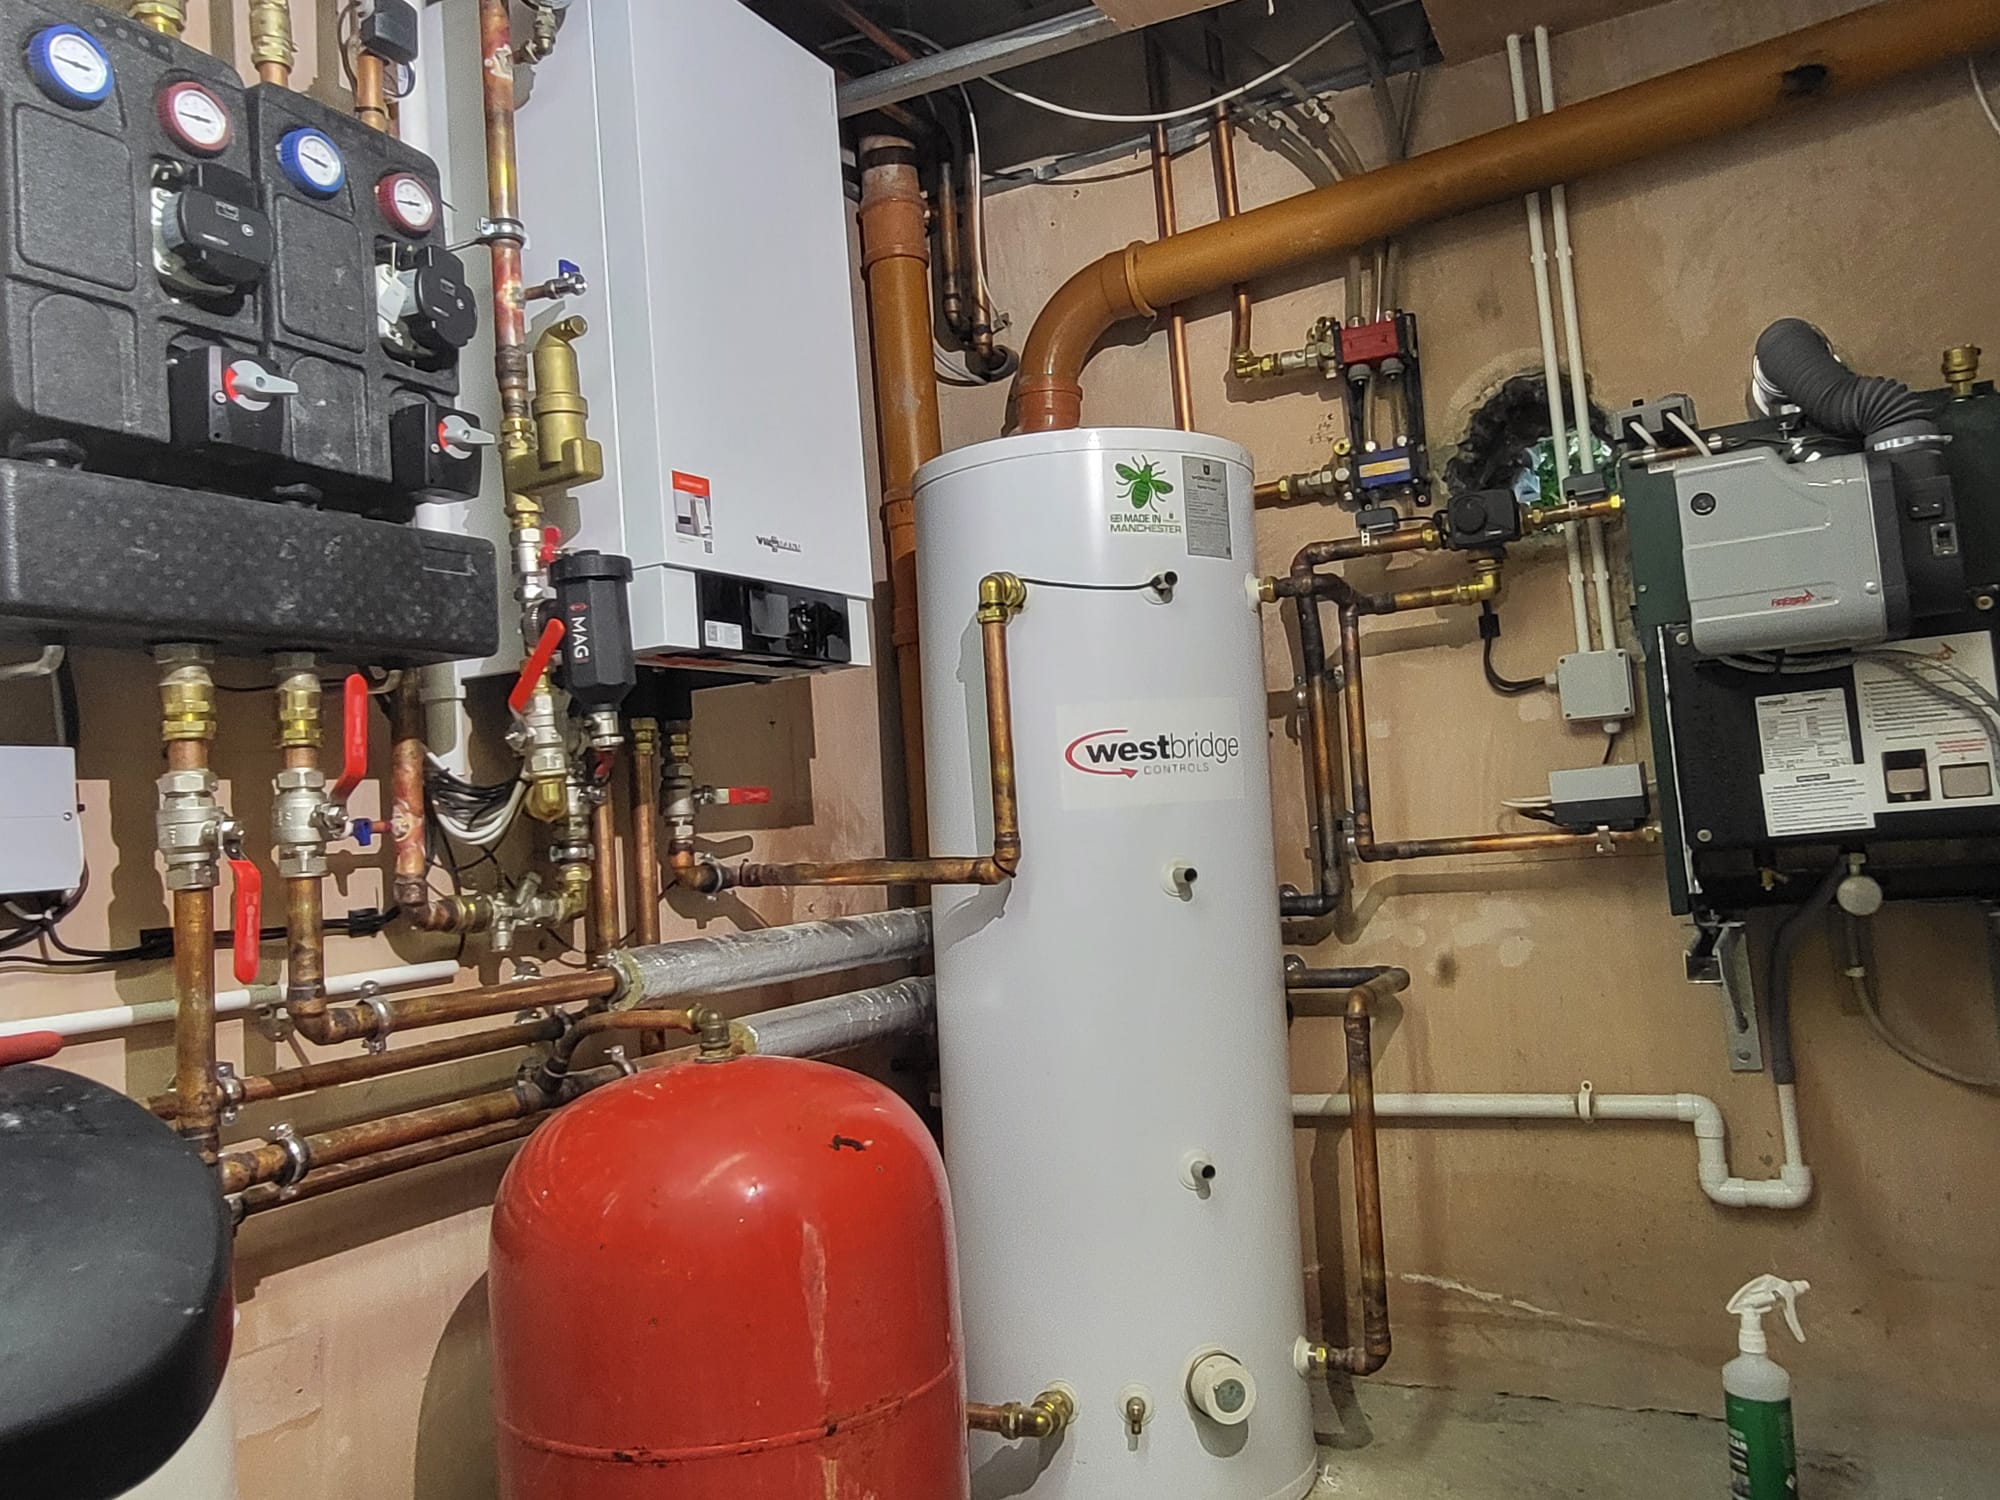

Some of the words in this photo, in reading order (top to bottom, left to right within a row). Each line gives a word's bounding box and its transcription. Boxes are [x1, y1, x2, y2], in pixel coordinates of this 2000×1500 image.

[1124, 513, 1150, 523] MADE
[1152, 514, 1161, 523] IN
[1110, 524, 1182, 534] MANCHESTER
[1085, 731, 1239, 764] westbridge
[1143, 763, 1210, 775] CONTROLS
